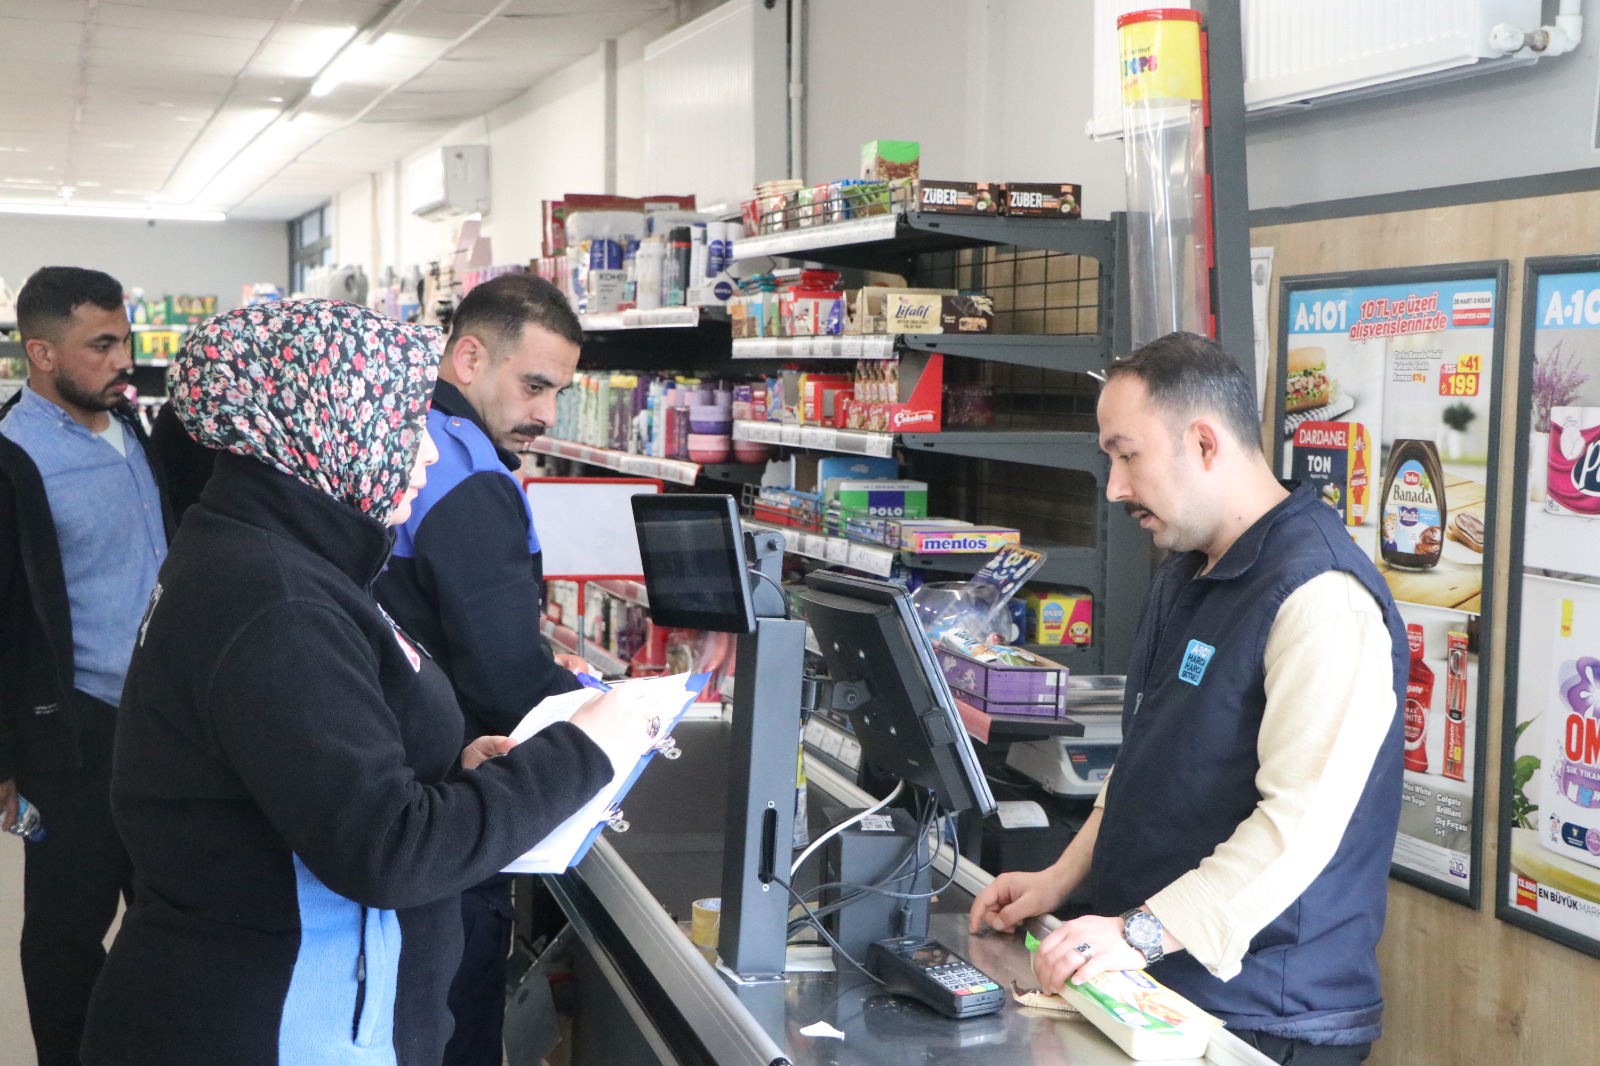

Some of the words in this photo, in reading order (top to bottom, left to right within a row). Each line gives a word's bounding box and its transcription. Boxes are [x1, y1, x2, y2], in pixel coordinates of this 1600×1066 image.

[922, 188, 957, 205] ZÜBER
[1010, 191, 1043, 208] ZÜBER
[1360, 301, 1375, 320] 10
[1376, 299, 1390, 318] TL
[1391, 300, 1406, 316] ve
[1407, 293, 1437, 315] üzeri
[1350, 312, 1447, 343] alışverişlerinizde
[1299, 429, 1347, 448] DARDANEL
[1307, 455, 1332, 474] TON
[1393, 485, 1433, 504] Banada
[869, 506, 904, 517] POLO
[923, 537, 988, 551] mentos
[1406, 685, 1424, 695] gate
[1414, 785, 1432, 797] White
[1436, 794, 1462, 807] Colgate
[1436, 805, 1462, 819] Brilliant
[1434, 828, 1446, 838] 1+1
[1518, 887, 1537, 901] MARKET
[1538, 888, 1549, 900] EN
[1551, 892, 1579, 911] BÜYÜK
